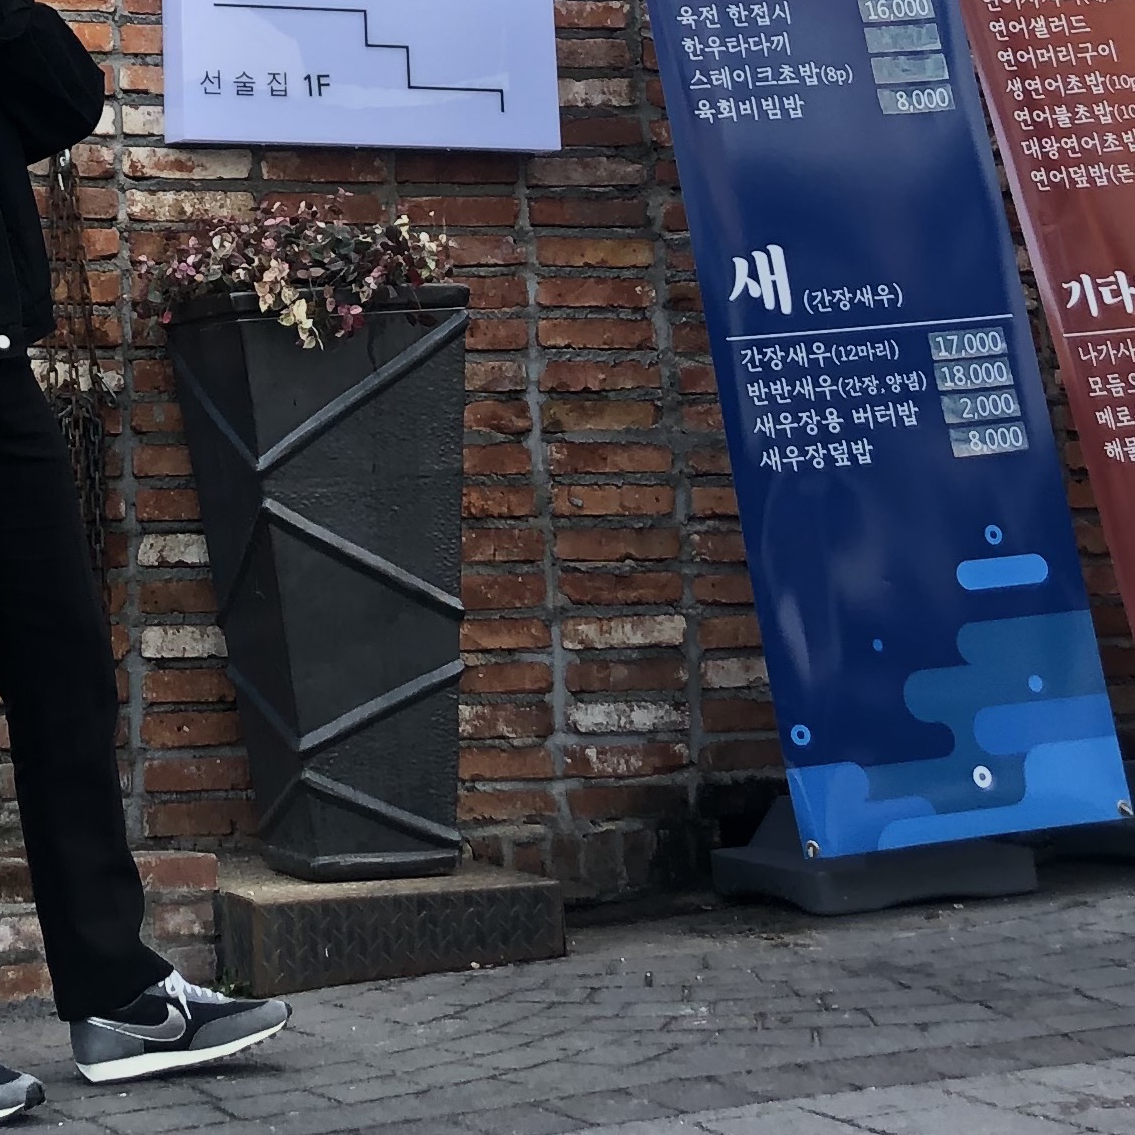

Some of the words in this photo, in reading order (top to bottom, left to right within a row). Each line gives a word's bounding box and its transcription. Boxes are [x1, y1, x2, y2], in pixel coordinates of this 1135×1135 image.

[676, 4, 721, 29] 육전
[726, 1, 791, 27] 한접시
[989, 14, 1092, 41] 연어샐러드
[682, 32, 791, 60] 한우타다끼
[997, 39, 1118, 71] 연어머리구이
[199, 69, 289, 98] 선술집
[303, 73, 331, 97] 1F
[694, 94, 805, 123] 육회비빔밥
[896, 87, 949, 112] 8,000
[729, 244, 792, 315] 새
[803, 283, 903, 315] (간장새우)
[1061, 270, 1135, 317] 기타
[935, 330, 1003, 357] 17,000
[941, 361, 1008, 388] 18,000
[754, 408, 844, 439] 새우장용
[852, 400, 919, 430] 버터밥
[959, 393, 1015, 419] 2,000
[760, 437, 873, 473] 새우장덮밥
[968, 425, 1024, 453] 8,000
